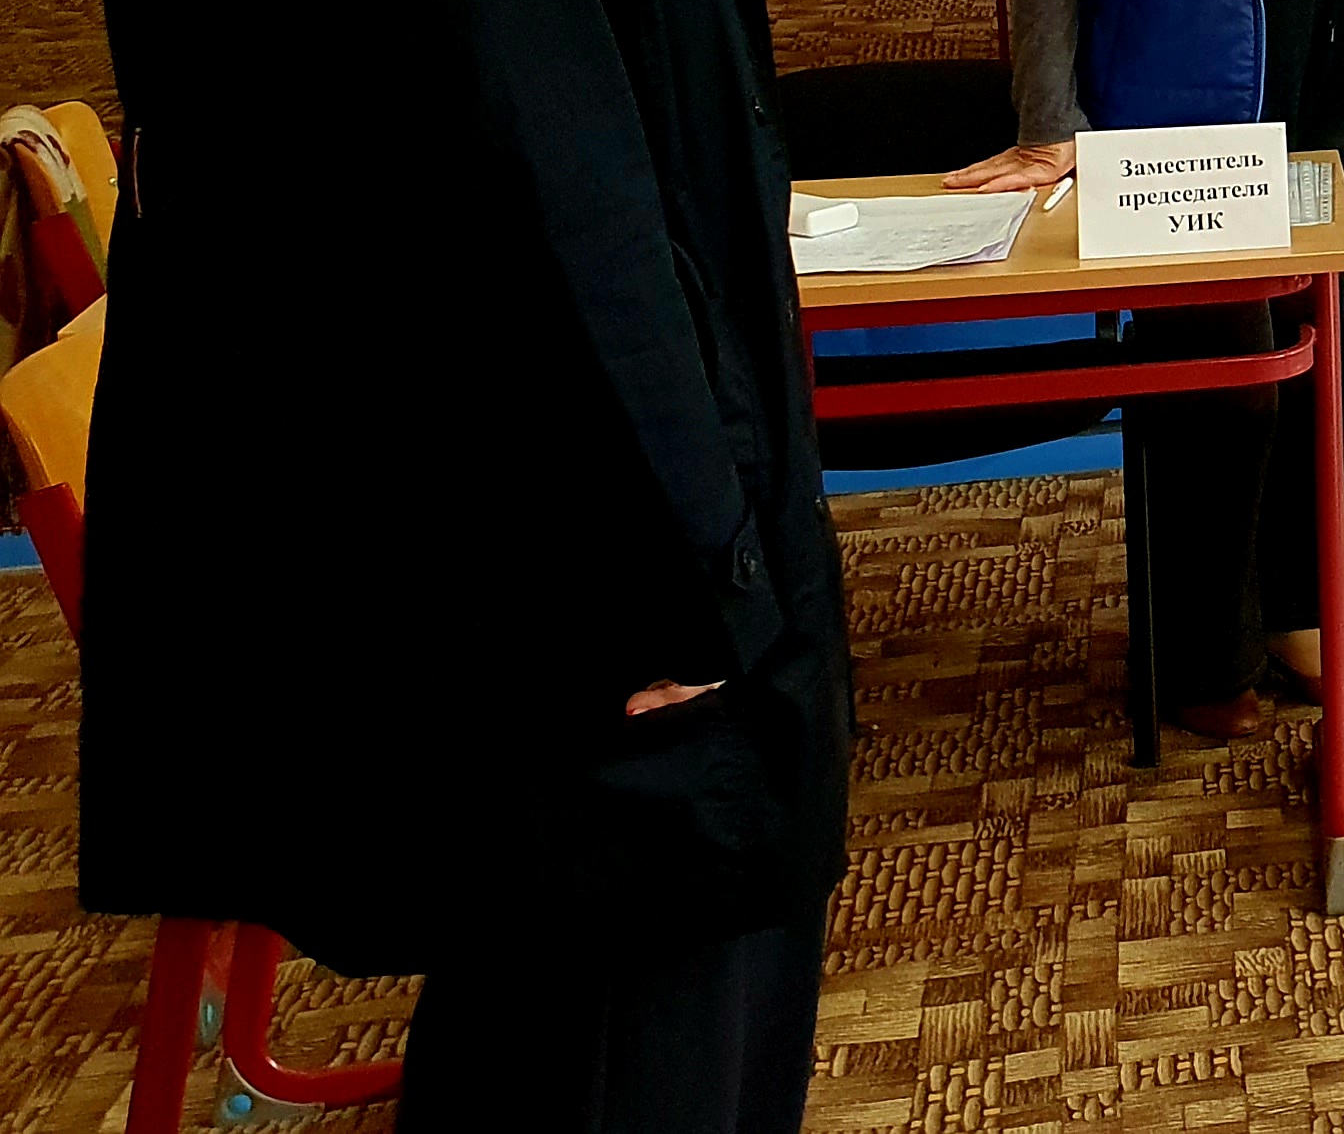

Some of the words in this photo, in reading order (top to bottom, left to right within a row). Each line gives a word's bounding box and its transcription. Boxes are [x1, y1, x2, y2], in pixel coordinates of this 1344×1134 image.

[1119, 154, 1264, 178] Заместитель
[1118, 183, 1269, 211] председателя
[1167, 211, 1224, 233] УИК
